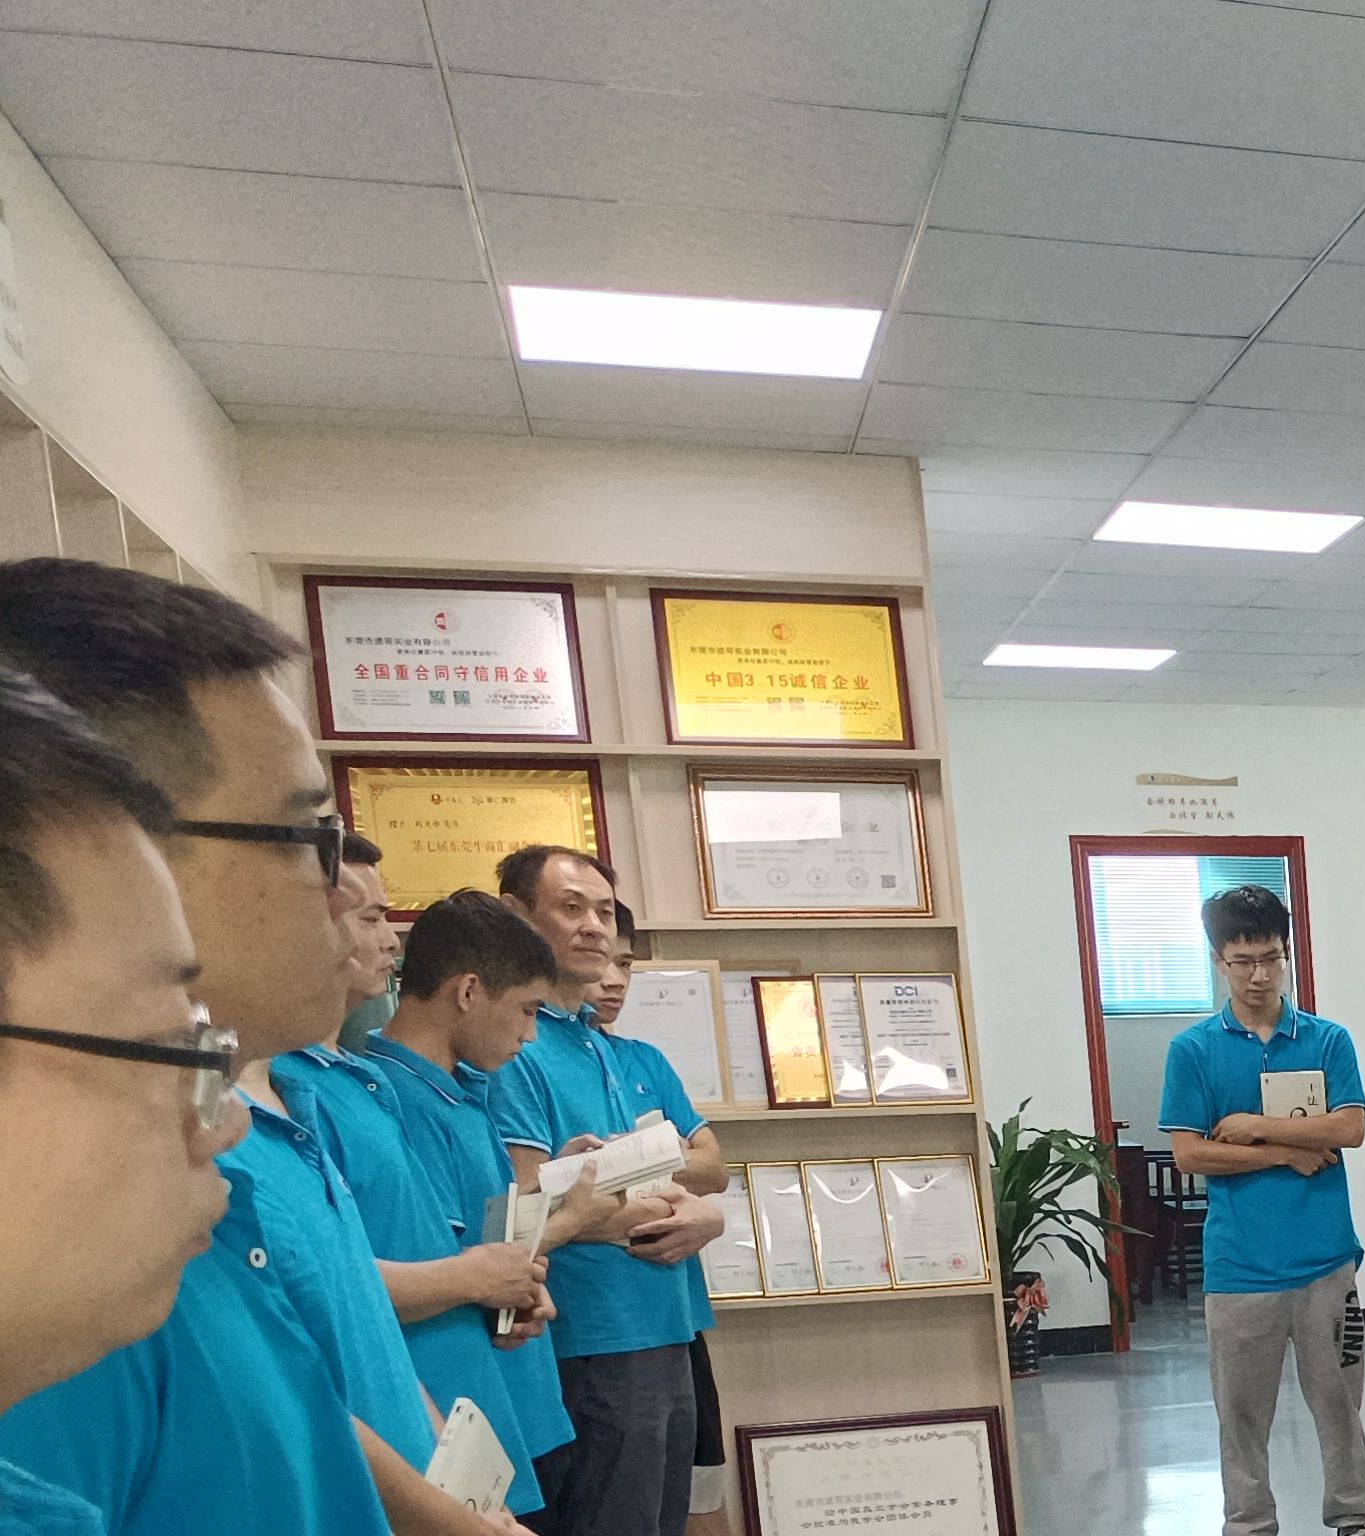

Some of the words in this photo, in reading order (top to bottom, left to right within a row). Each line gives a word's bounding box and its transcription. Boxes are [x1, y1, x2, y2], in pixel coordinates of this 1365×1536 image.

[354, 663, 549, 683] 全国重合同守信用企业
[894, 986, 919, 996] DCI
[1341, 1290, 1364, 1368] CHINA
